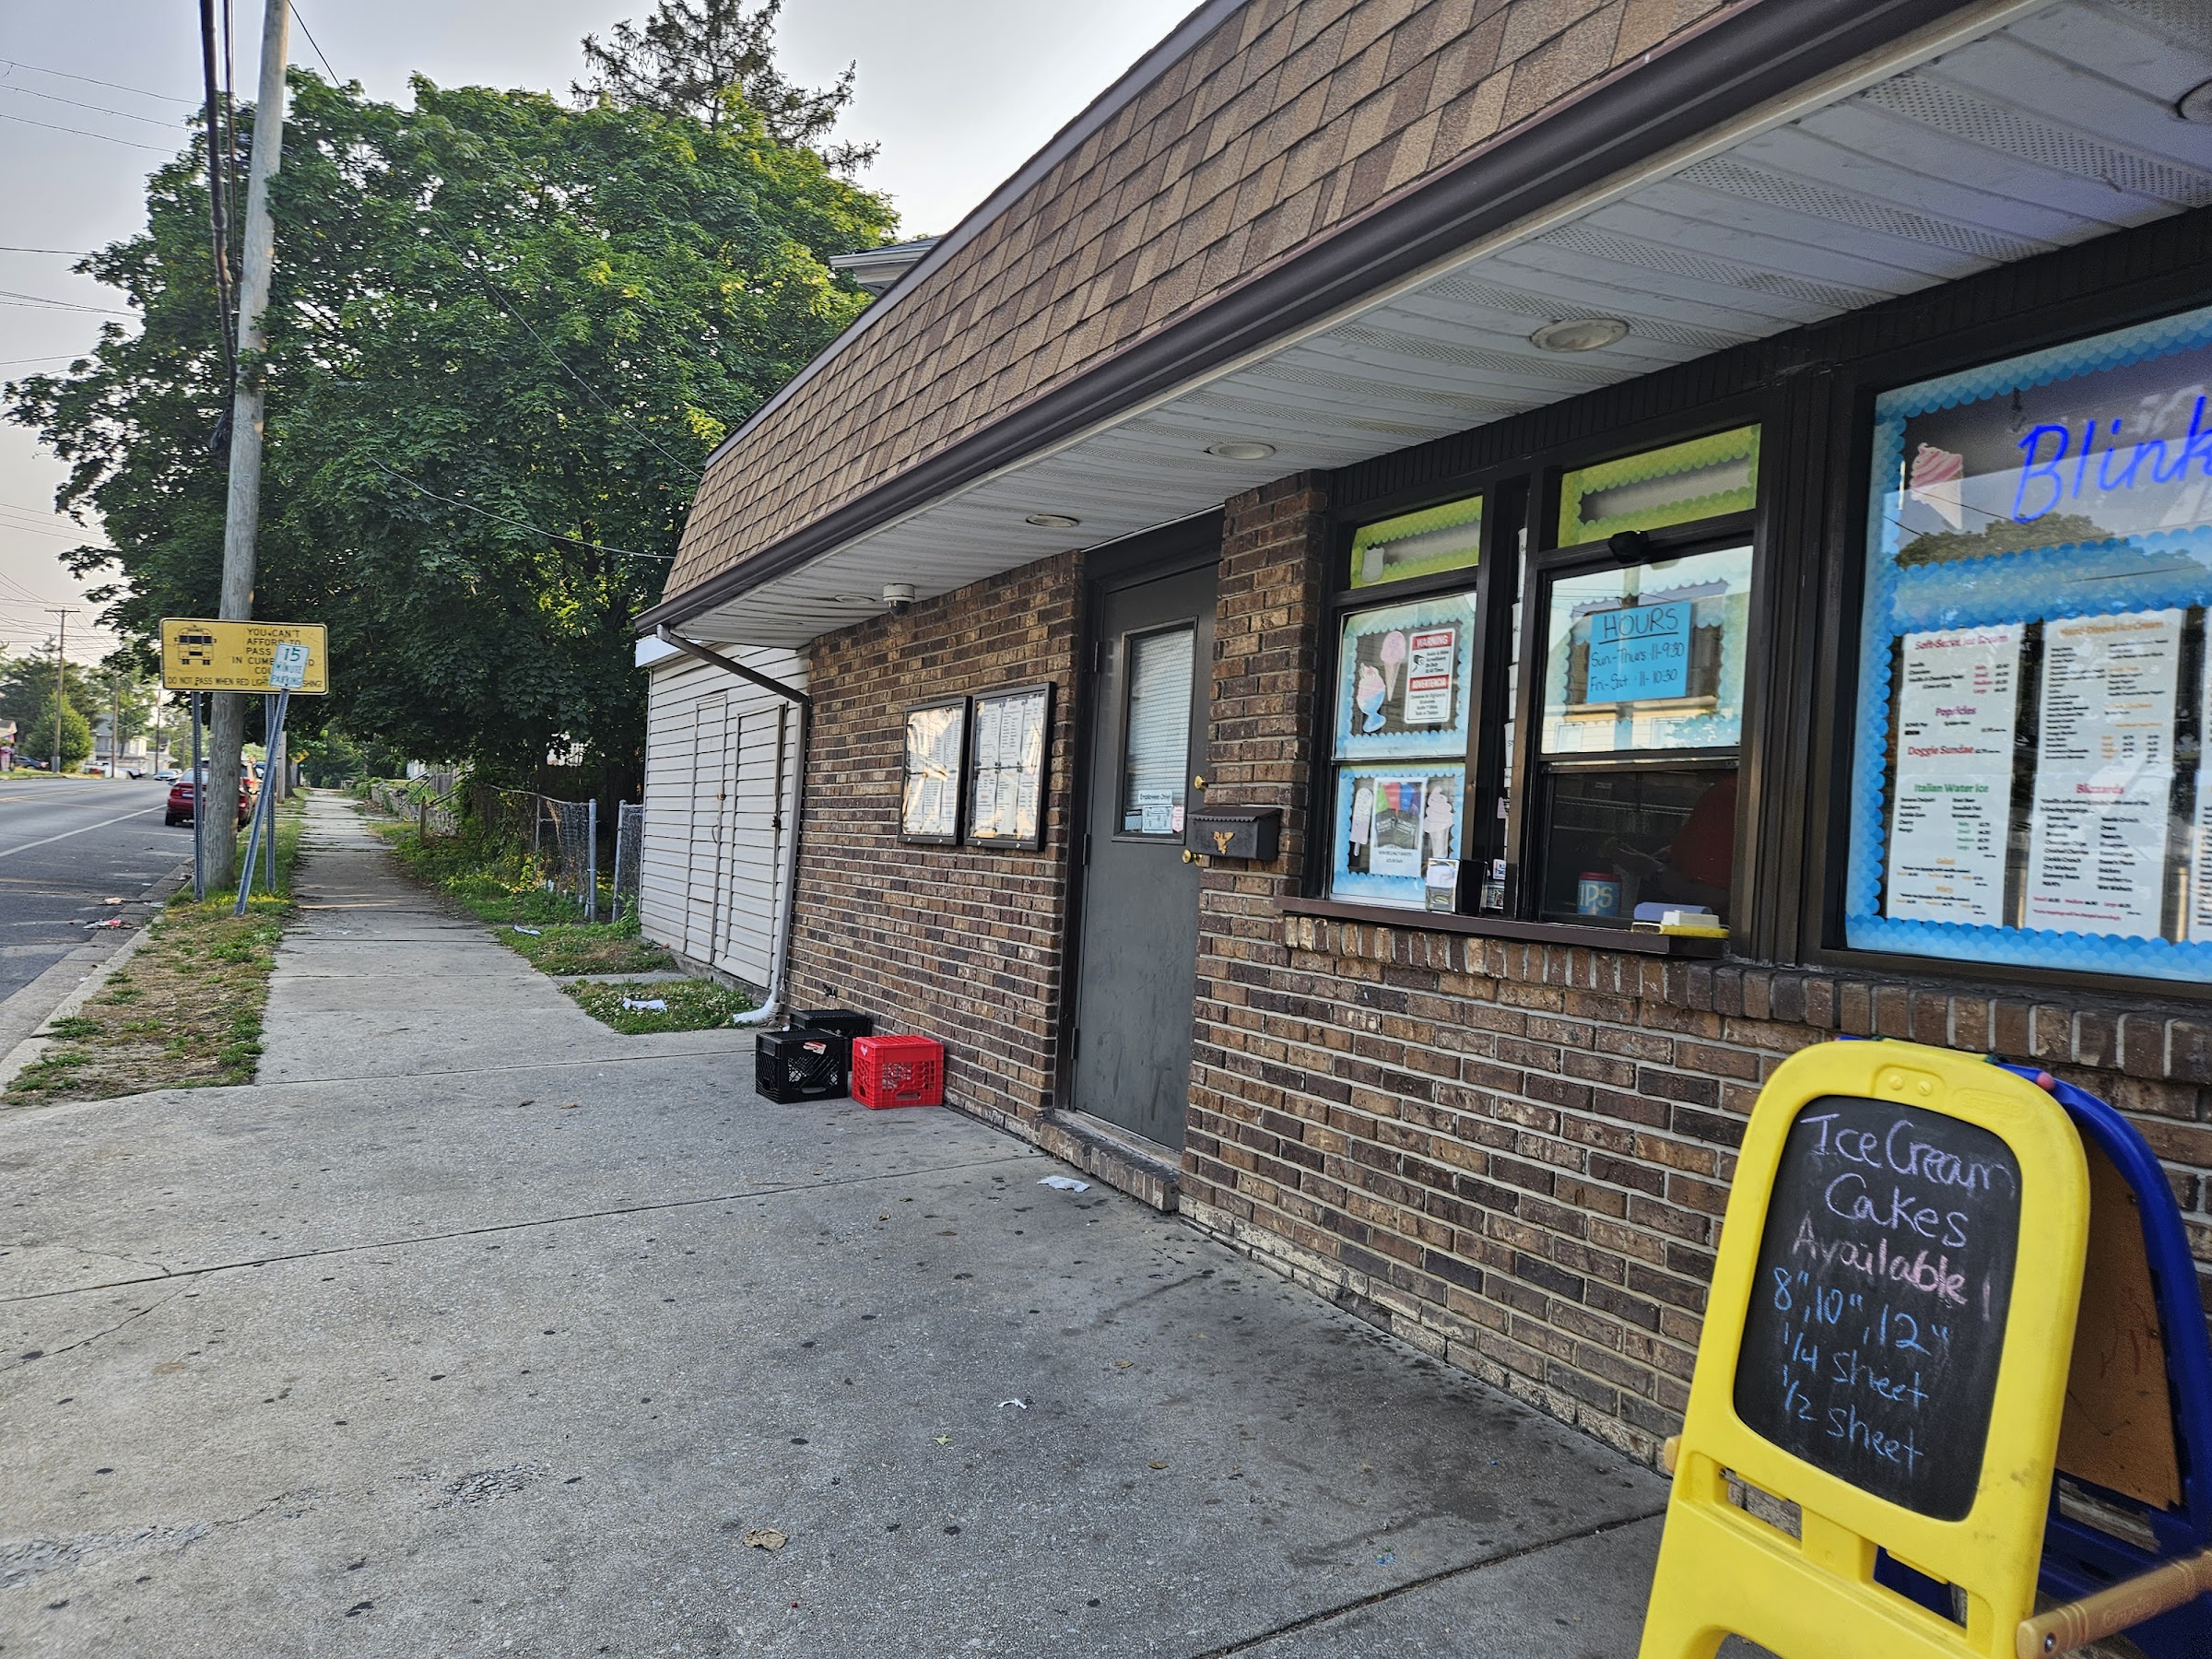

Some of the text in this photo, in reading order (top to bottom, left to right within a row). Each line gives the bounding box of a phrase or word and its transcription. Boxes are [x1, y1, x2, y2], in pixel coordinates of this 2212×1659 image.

[1604, 607, 1679, 639] HOURS
[246, 628, 300, 638] YOU CAN'T
[246, 638, 285, 646] AFFORD
[1416, 634, 1449, 648] WARNING
[245, 647, 272, 655] PASS
[284, 647, 301, 662] 15
[276, 664, 302, 674] MINUTE
[195, 677, 213, 686] PASS
[215, 677, 234, 686] WHEN
[271, 675, 302, 686] PARKING
[1936, 705, 1976, 718] Popsicles
[1908, 746, 1938, 758] Doggie
[1939, 745, 1974, 754] Sundae
[1914, 783, 1943, 793] Italian
[1945, 783, 1973, 793] Water
[1799, 1112, 2017, 1198] Ice Cream
[1824, 1172, 1970, 1248] Cakes
[1792, 1209, 1969, 1309] Available
[1783, 1321, 1818, 1373] 1/4
[1783, 1364, 1818, 1422] 1/2
